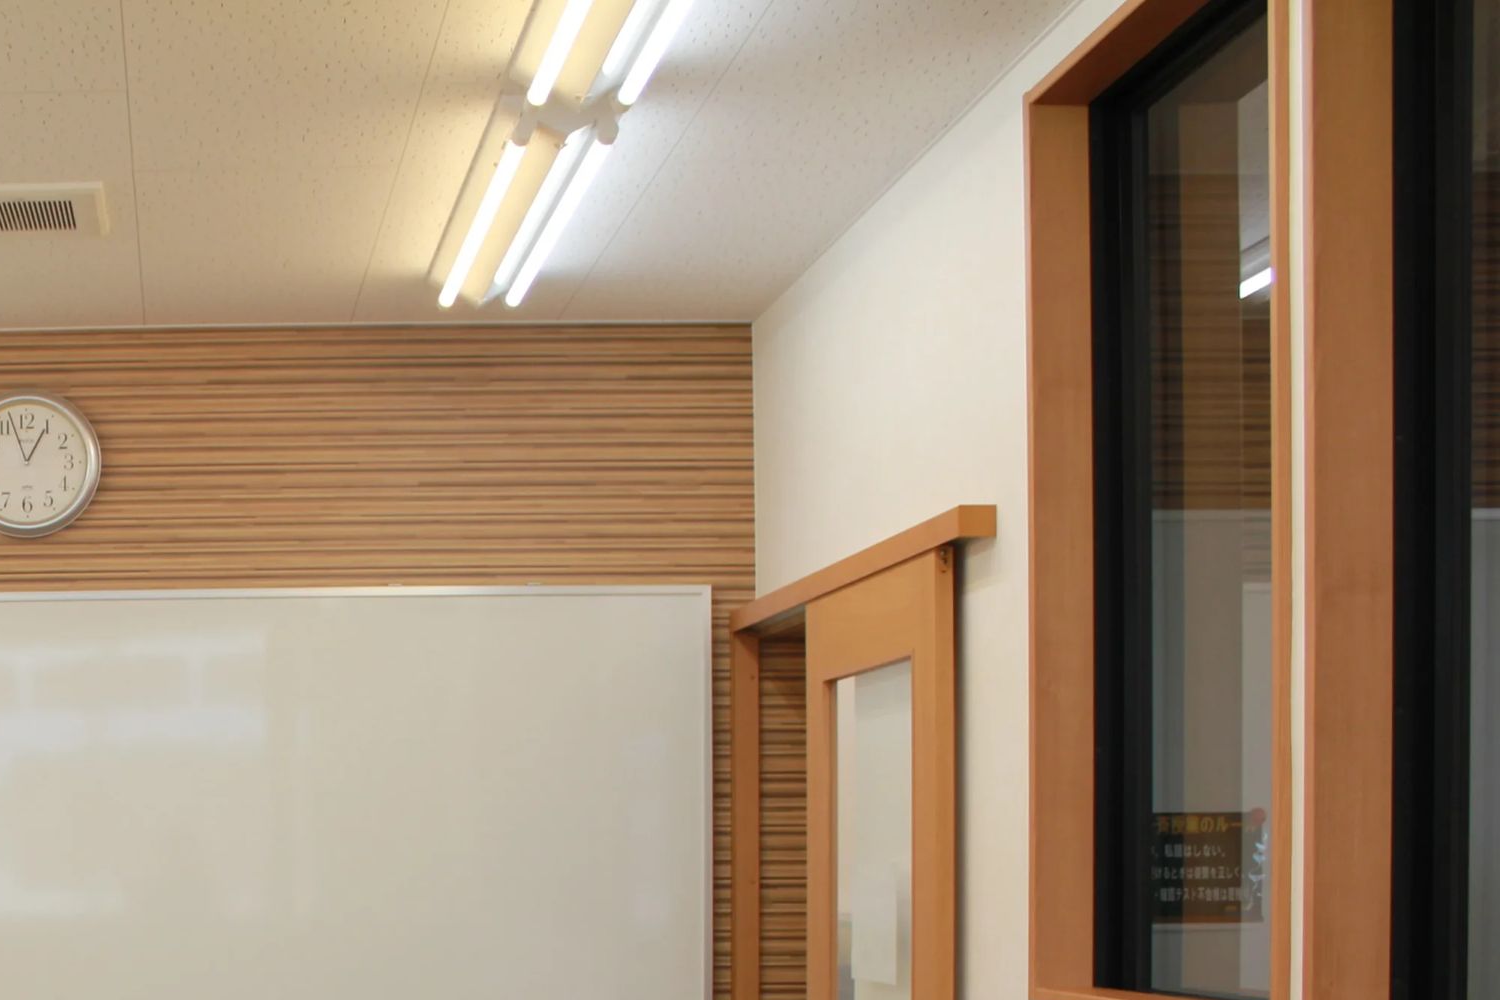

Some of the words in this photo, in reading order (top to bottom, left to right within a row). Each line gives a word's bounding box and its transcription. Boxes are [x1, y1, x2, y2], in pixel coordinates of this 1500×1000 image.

[0, 420, 10, 435] 11
[19, 413, 35, 429] 12
[58, 433, 68, 449] 2
[64, 454, 74, 470] 3
[60, 476, 69, 491] 4
[1, 492, 11, 509] 7
[22, 497, 33, 513] 6
[43, 491, 53, 507] 5
